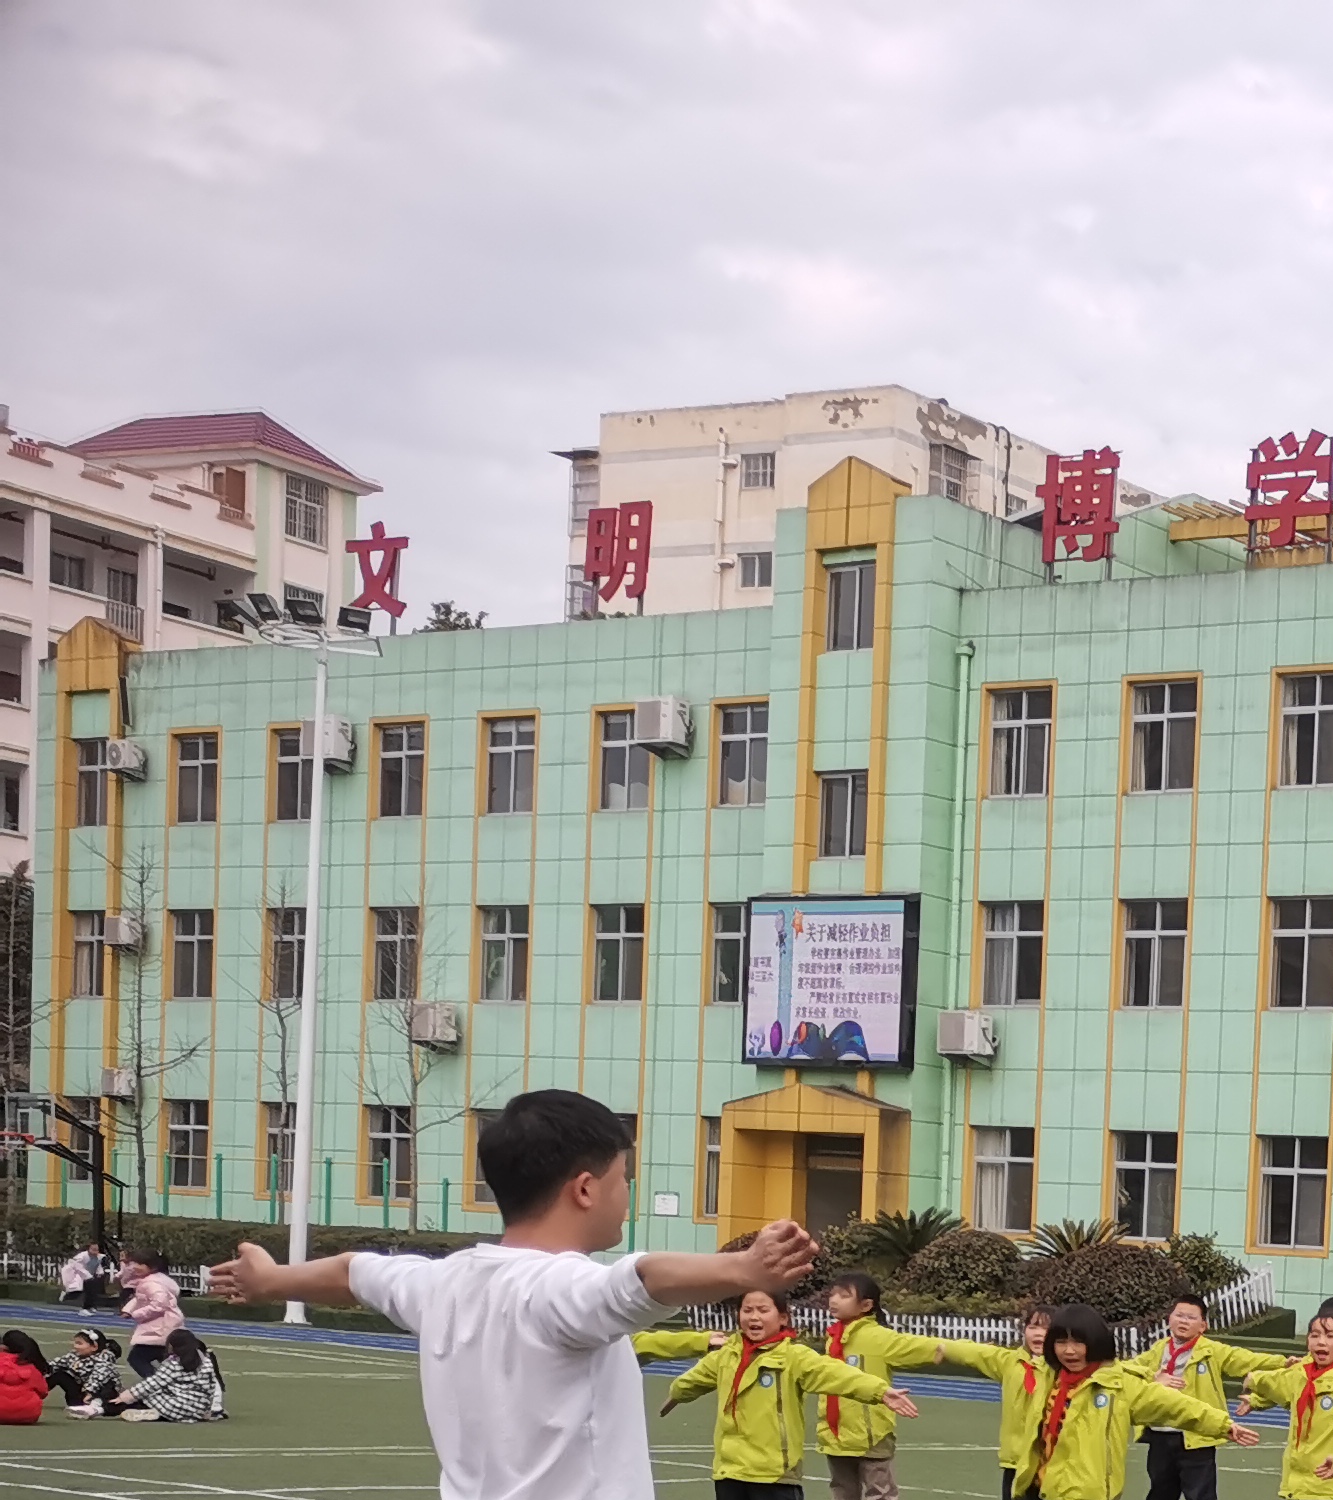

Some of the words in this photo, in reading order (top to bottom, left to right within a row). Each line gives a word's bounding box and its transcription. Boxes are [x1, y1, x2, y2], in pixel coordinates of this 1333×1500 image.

[804, 922, 892, 944] 关于减轻作业负担
